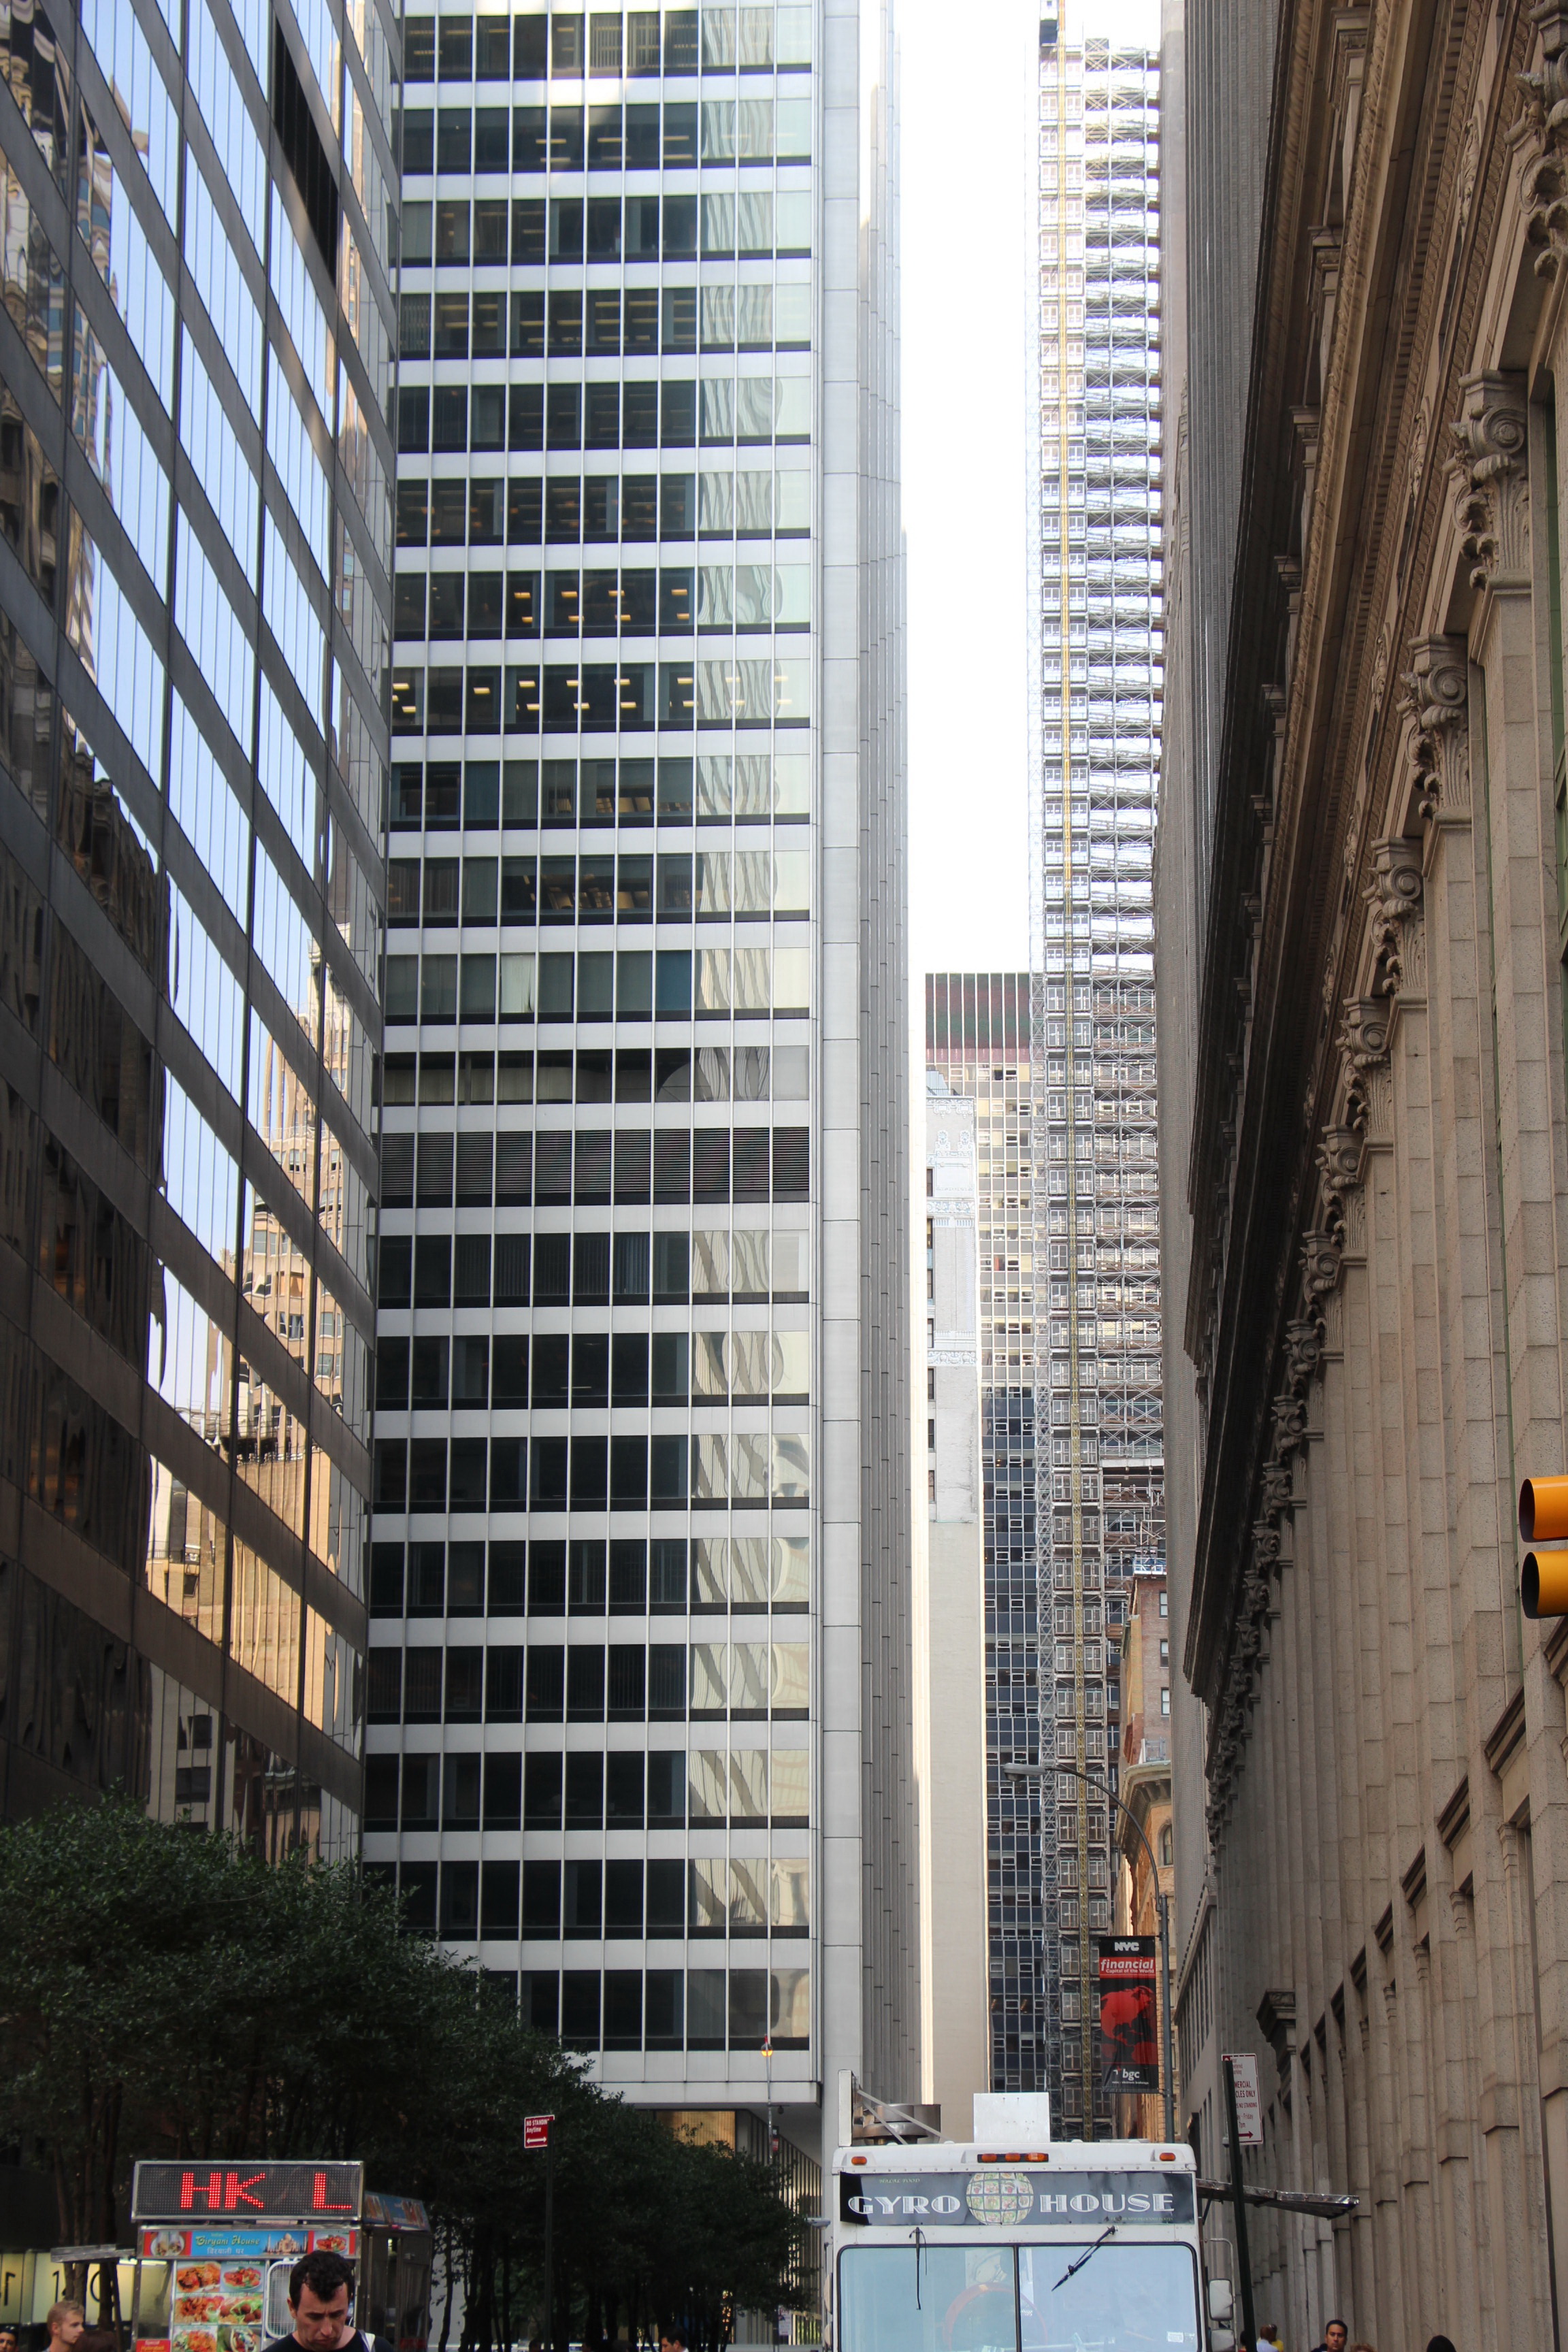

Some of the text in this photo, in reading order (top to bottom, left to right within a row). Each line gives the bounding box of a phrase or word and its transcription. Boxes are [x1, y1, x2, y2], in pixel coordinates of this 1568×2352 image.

[1114, 1942, 1139, 1951] NYC
[1100, 1959, 1154, 1971] financial
[1122, 2069, 1140, 2081] bgc
[1234, 2080, 1252, 2089] MERCIAL
[180, 2172, 352, 2210] HK L
[848, 2193, 1175, 2215] GYRO HOUSE
[195, 2235, 260, 2247] Biryani House
